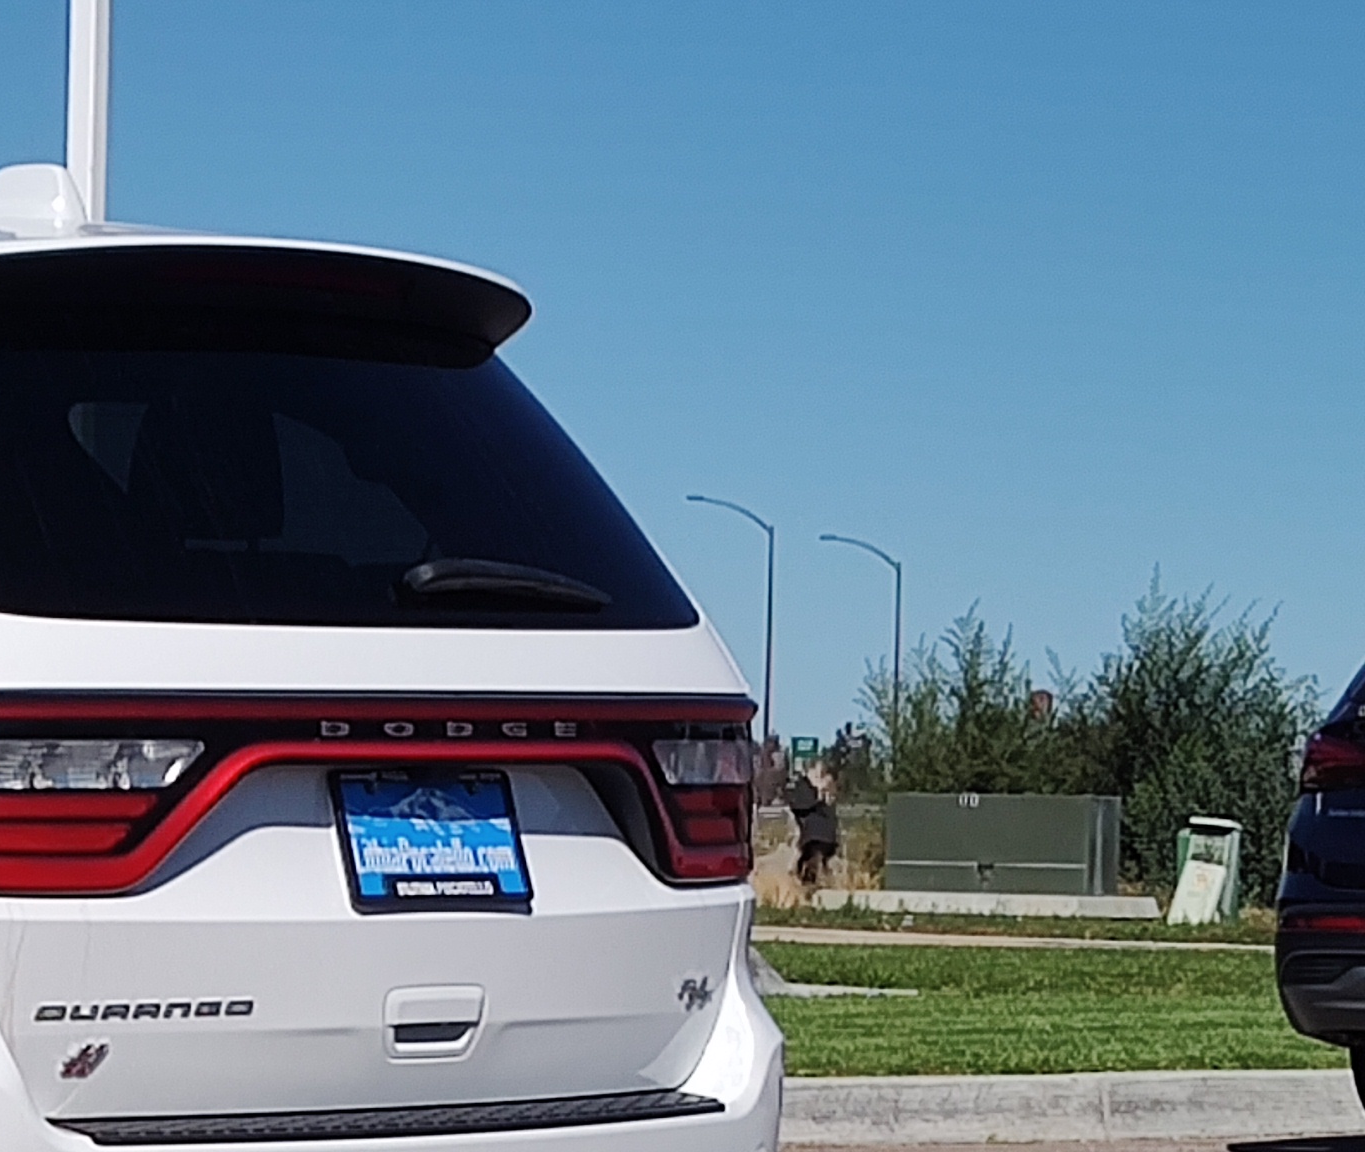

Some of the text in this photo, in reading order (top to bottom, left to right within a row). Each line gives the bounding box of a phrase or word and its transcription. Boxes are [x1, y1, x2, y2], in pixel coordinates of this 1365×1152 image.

[321, 720, 577, 738] DODGE
[350, 836, 518, 874] LithiaPocatello.com
[33, 999, 255, 1022] DURANGO
